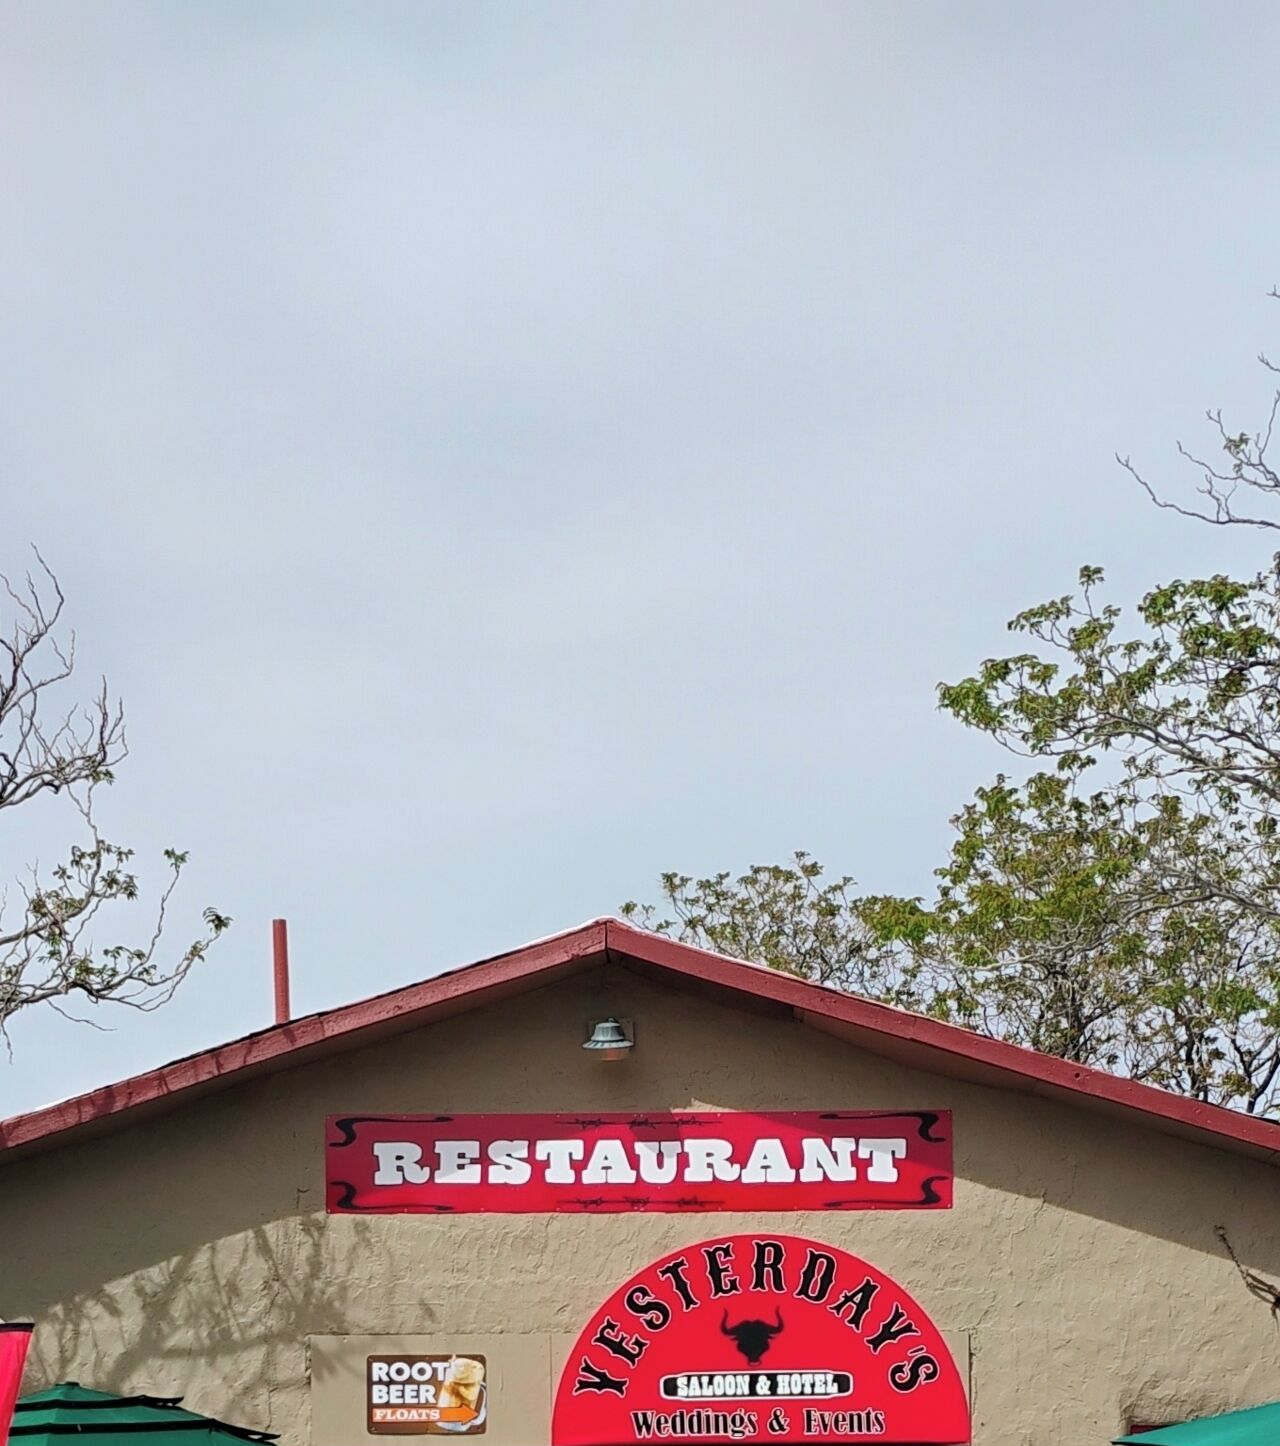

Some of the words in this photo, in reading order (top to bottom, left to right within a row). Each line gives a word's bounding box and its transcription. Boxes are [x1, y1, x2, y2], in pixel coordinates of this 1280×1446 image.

[372, 1137, 907, 1186] RESTAURANT
[573, 1240, 940, 1397] YESTERDAY'S
[371, 1361, 450, 1382] ROOT
[371, 1384, 437, 1404] BEER
[676, 1375, 750, 1397] SALOON
[755, 1375, 772, 1396] &
[776, 1373, 839, 1395] HOTEL
[375, 1408, 440, 1421] FLOATS
[631, 1408, 758, 1439] Weddings
[768, 1407, 790, 1434] &
[803, 1407, 886, 1435] Events
